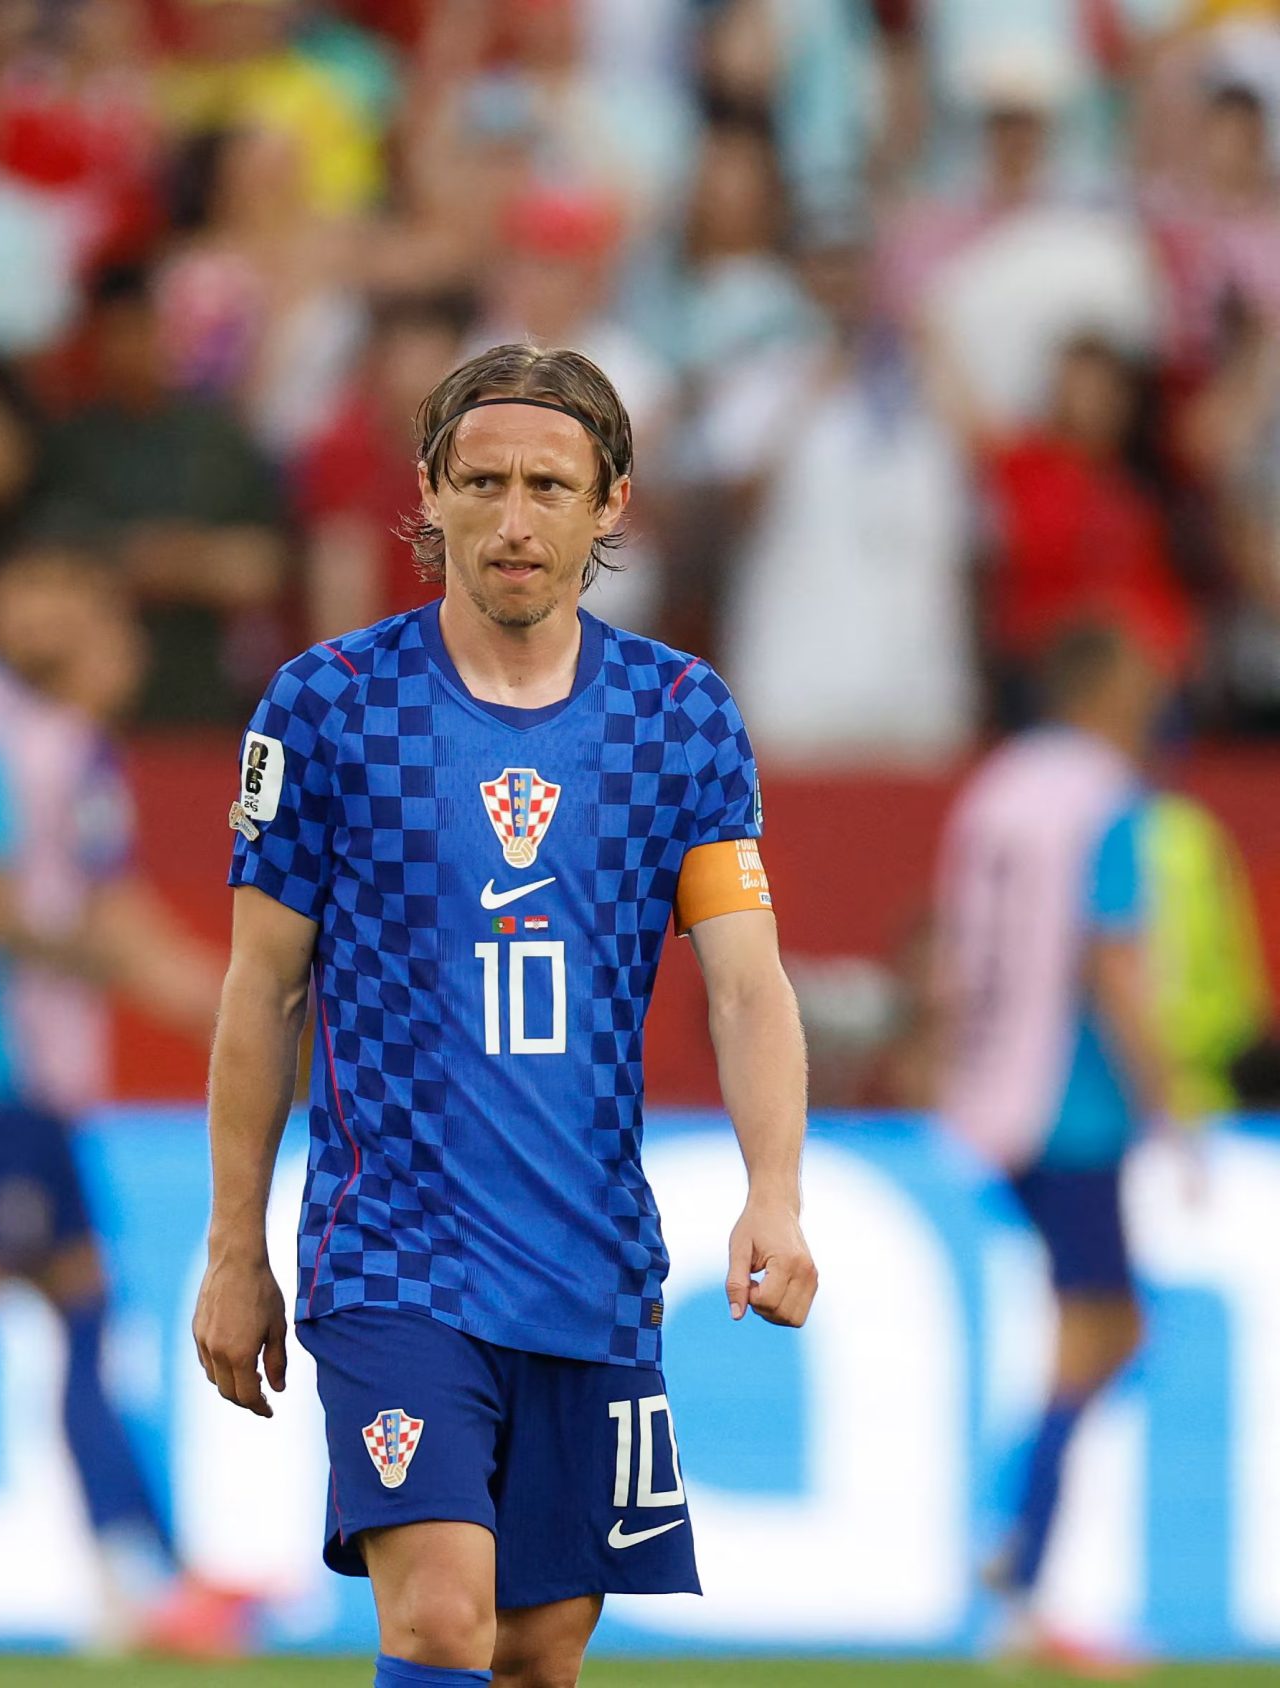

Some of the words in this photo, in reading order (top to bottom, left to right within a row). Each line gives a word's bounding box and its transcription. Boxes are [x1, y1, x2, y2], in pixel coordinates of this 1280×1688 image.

[513, 778, 526, 828] HNS
[474, 941, 566, 1056] 10
[608, 1394, 686, 1508] 10
